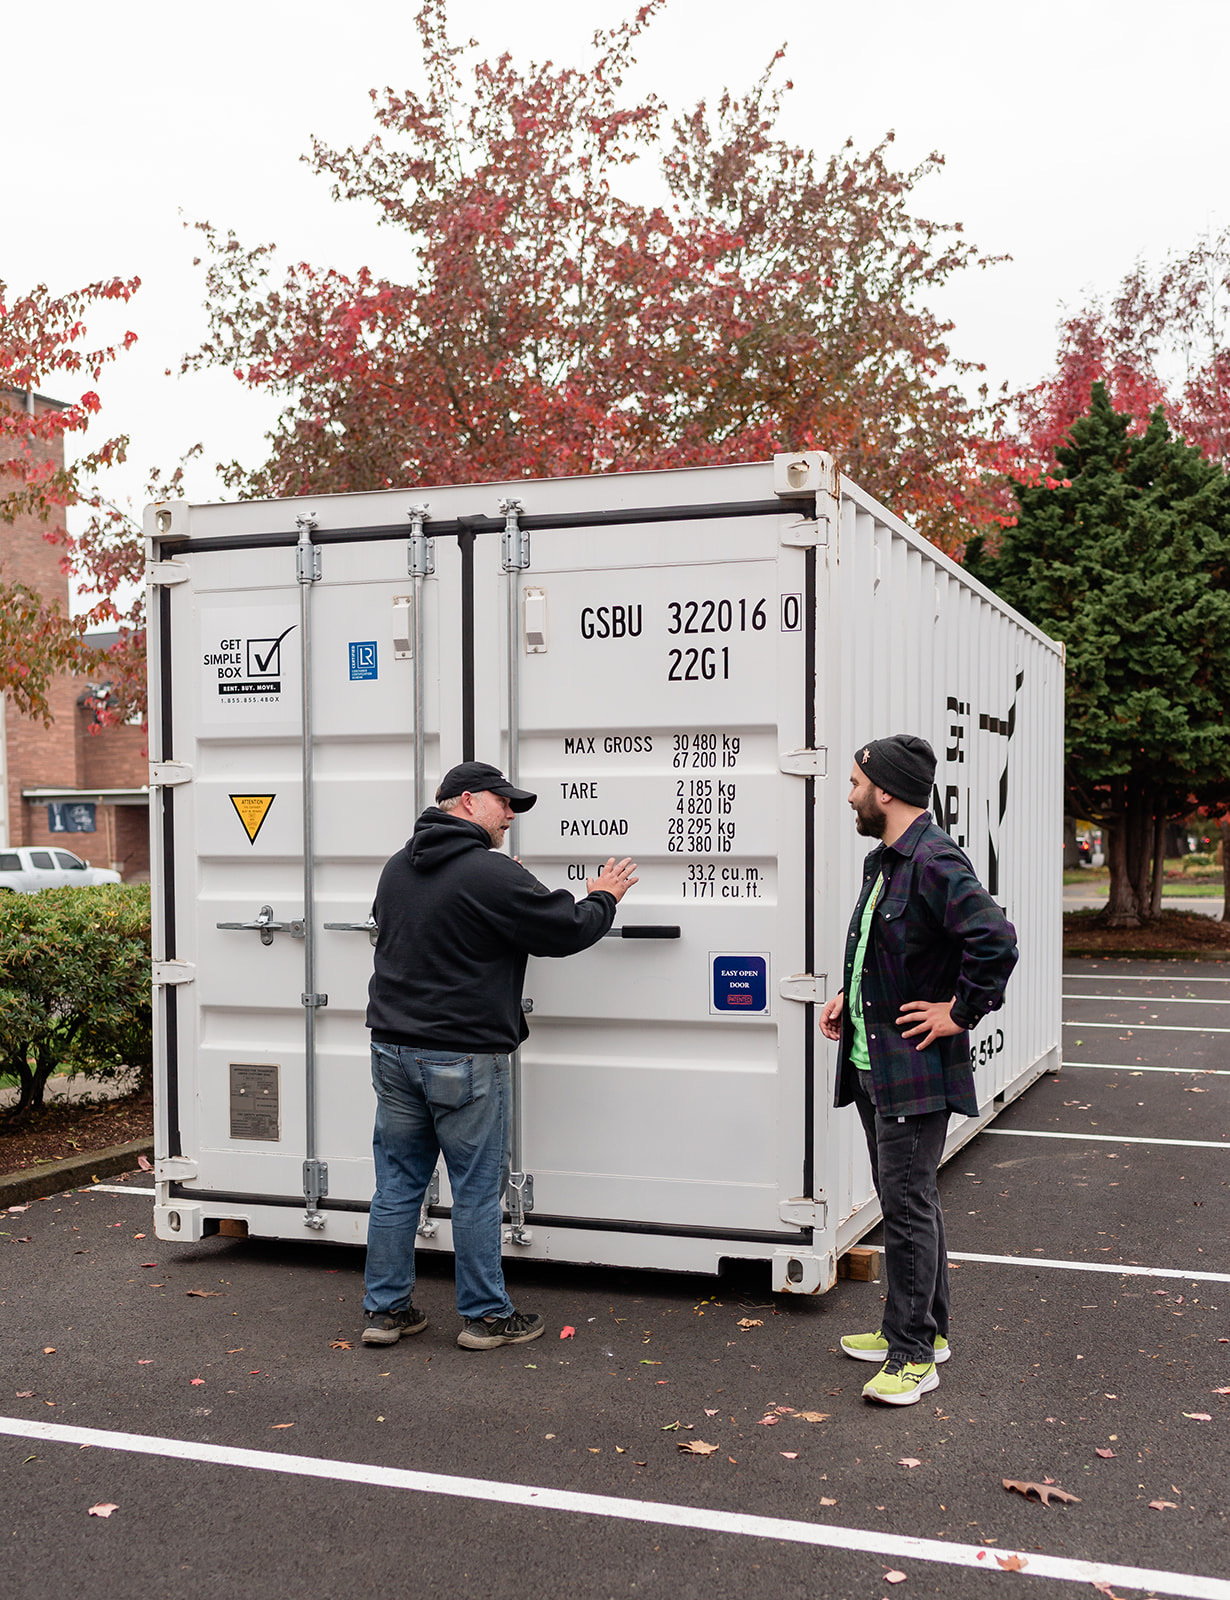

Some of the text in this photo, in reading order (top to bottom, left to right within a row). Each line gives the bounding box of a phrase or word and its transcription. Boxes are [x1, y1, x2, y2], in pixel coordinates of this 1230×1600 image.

[581, 596, 799, 640] GSBU 322016 0
[220, 638, 242, 651] GET
[203, 652, 242, 666] SIMPLE
[668, 646, 729, 682] 22G1
[217, 667, 242, 679] BOX
[221, 696, 280, 704] 1.855.855.4BOX
[564, 737, 596, 754] MAX
[604, 735, 653, 754] GROSS
[722, 733, 740, 757] kg
[722, 751, 738, 768] lb
[560, 782, 598, 800] TARE
[718, 779, 736, 801] kg
[718, 798, 734, 815] lb
[560, 819, 629, 836] PAYLOAD
[718, 818, 735, 840] kg
[718, 836, 734, 853] lb
[687, 863, 716, 881] 33.2
[721, 867, 764, 881] cu.m.
[721, 881, 761, 898] cu.ft.
